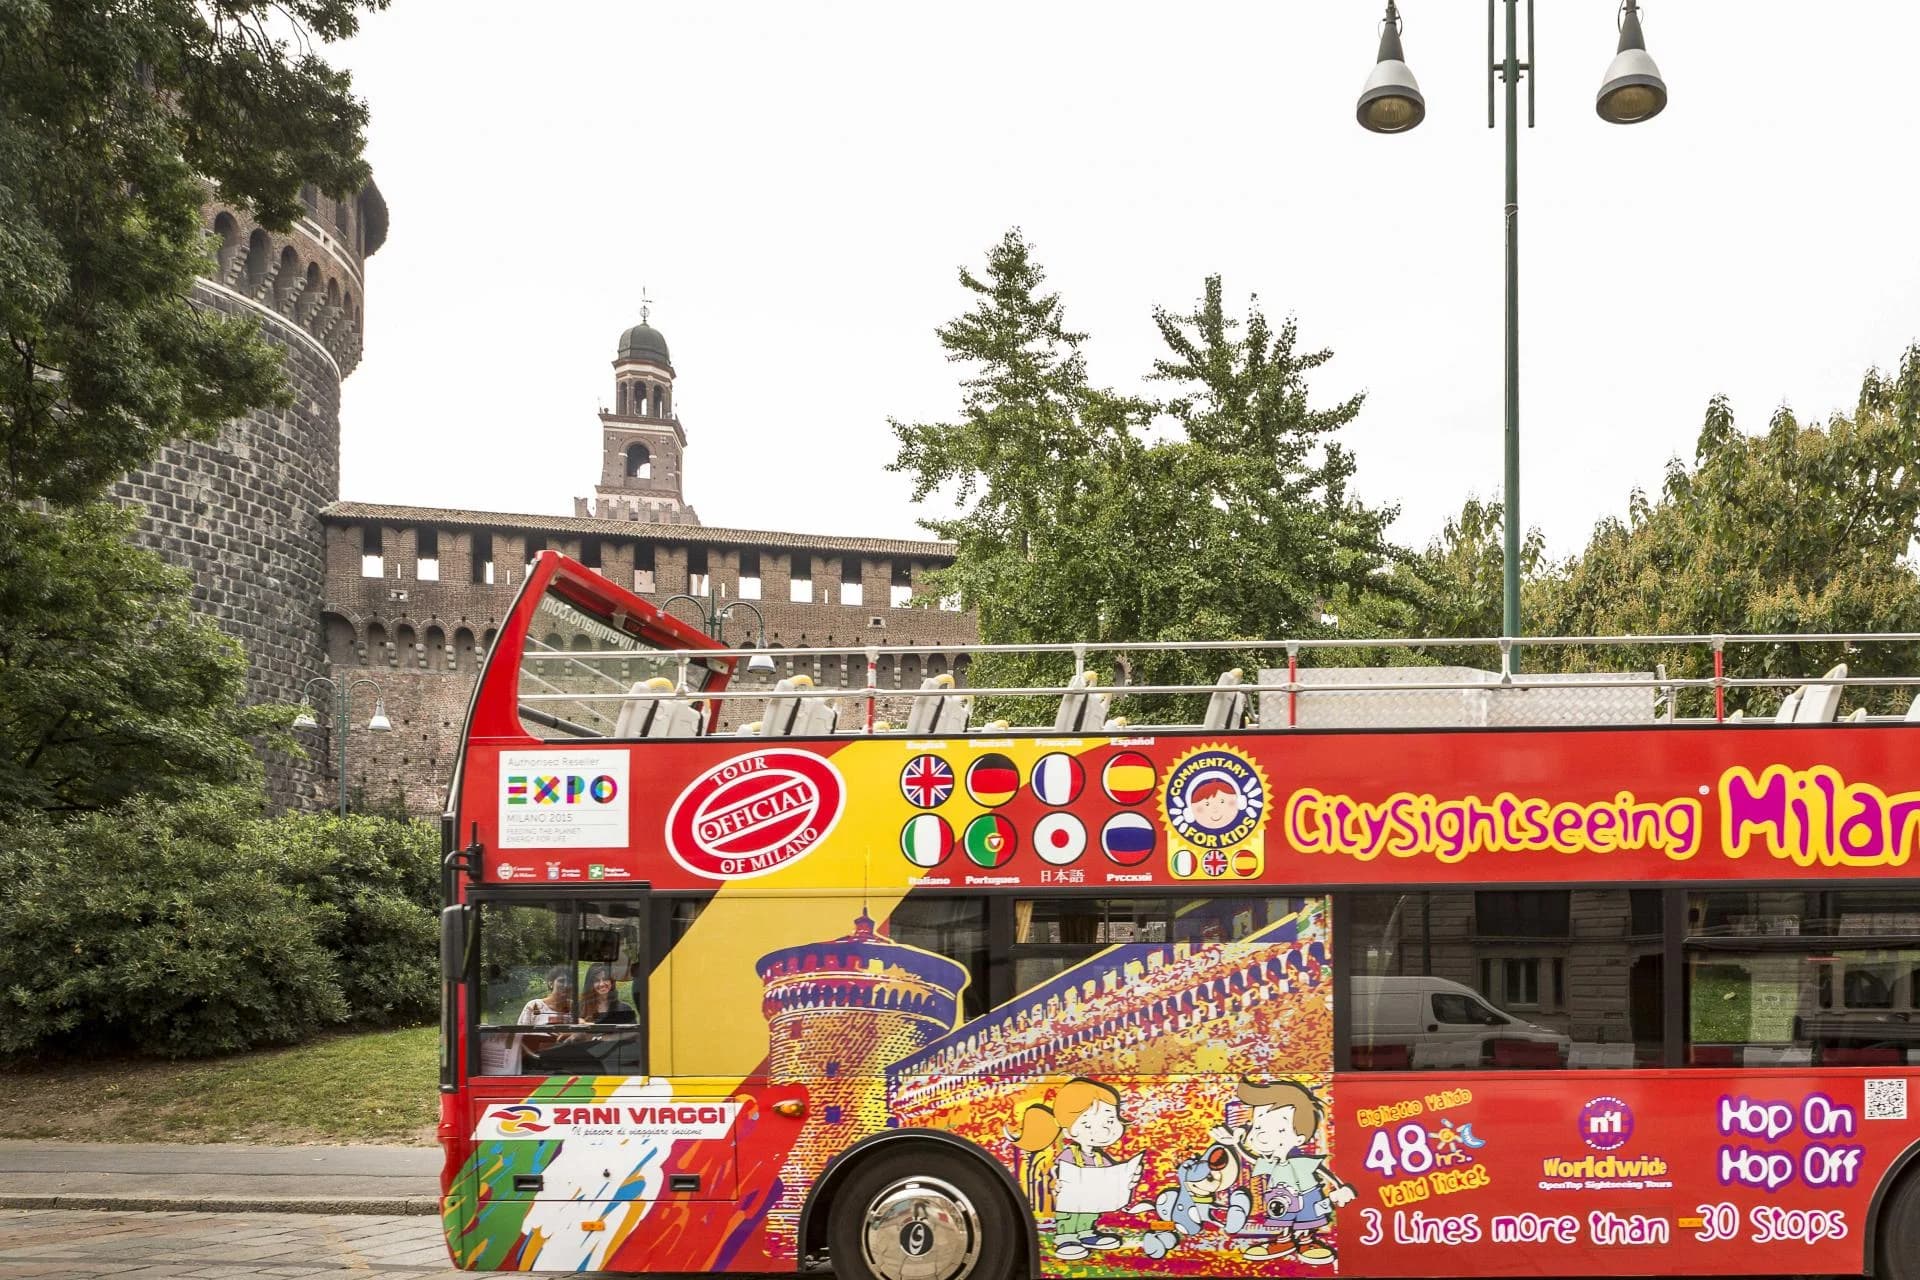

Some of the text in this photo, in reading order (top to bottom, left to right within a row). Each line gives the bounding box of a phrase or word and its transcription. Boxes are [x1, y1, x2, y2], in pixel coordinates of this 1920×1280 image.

[1110, 736, 1155, 748] Español
[709, 756, 769, 787] TOUR
[1170, 757, 1249, 796] COMMENTARY
[507, 775, 618, 805] EXPO
[506, 813, 574, 823] MILANO 2015
[700, 784, 814, 842] OFFICIAL
[1287, 791, 1699, 860] CitySightseeing
[1184, 816, 1256, 847] FOR KIDS
[720, 826, 818, 874] OF MILANO
[908, 875, 950, 886] Italiano
[1040, 869, 1084, 884] 日本語
[1106, 872, 1153, 883] Русский
[552, 1107, 726, 1125] ZANI VIAGGI
[1357, 1088, 1473, 1128] Biglietto Valido
[1720, 1095, 1853, 1140] Hop On
[1365, 1123, 1433, 1176] 48
[1542, 1154, 1668, 1179] Worldwide
[1720, 1145, 1860, 1189] Hop Off
[1379, 1164, 1491, 1208] Valid Ticket
[1584, 1180, 1644, 1191] Sightseeing
[1644, 1180, 1673, 1189] Tours
[1359, 1201, 1849, 1246] 3 Lines more than 30 Stops
